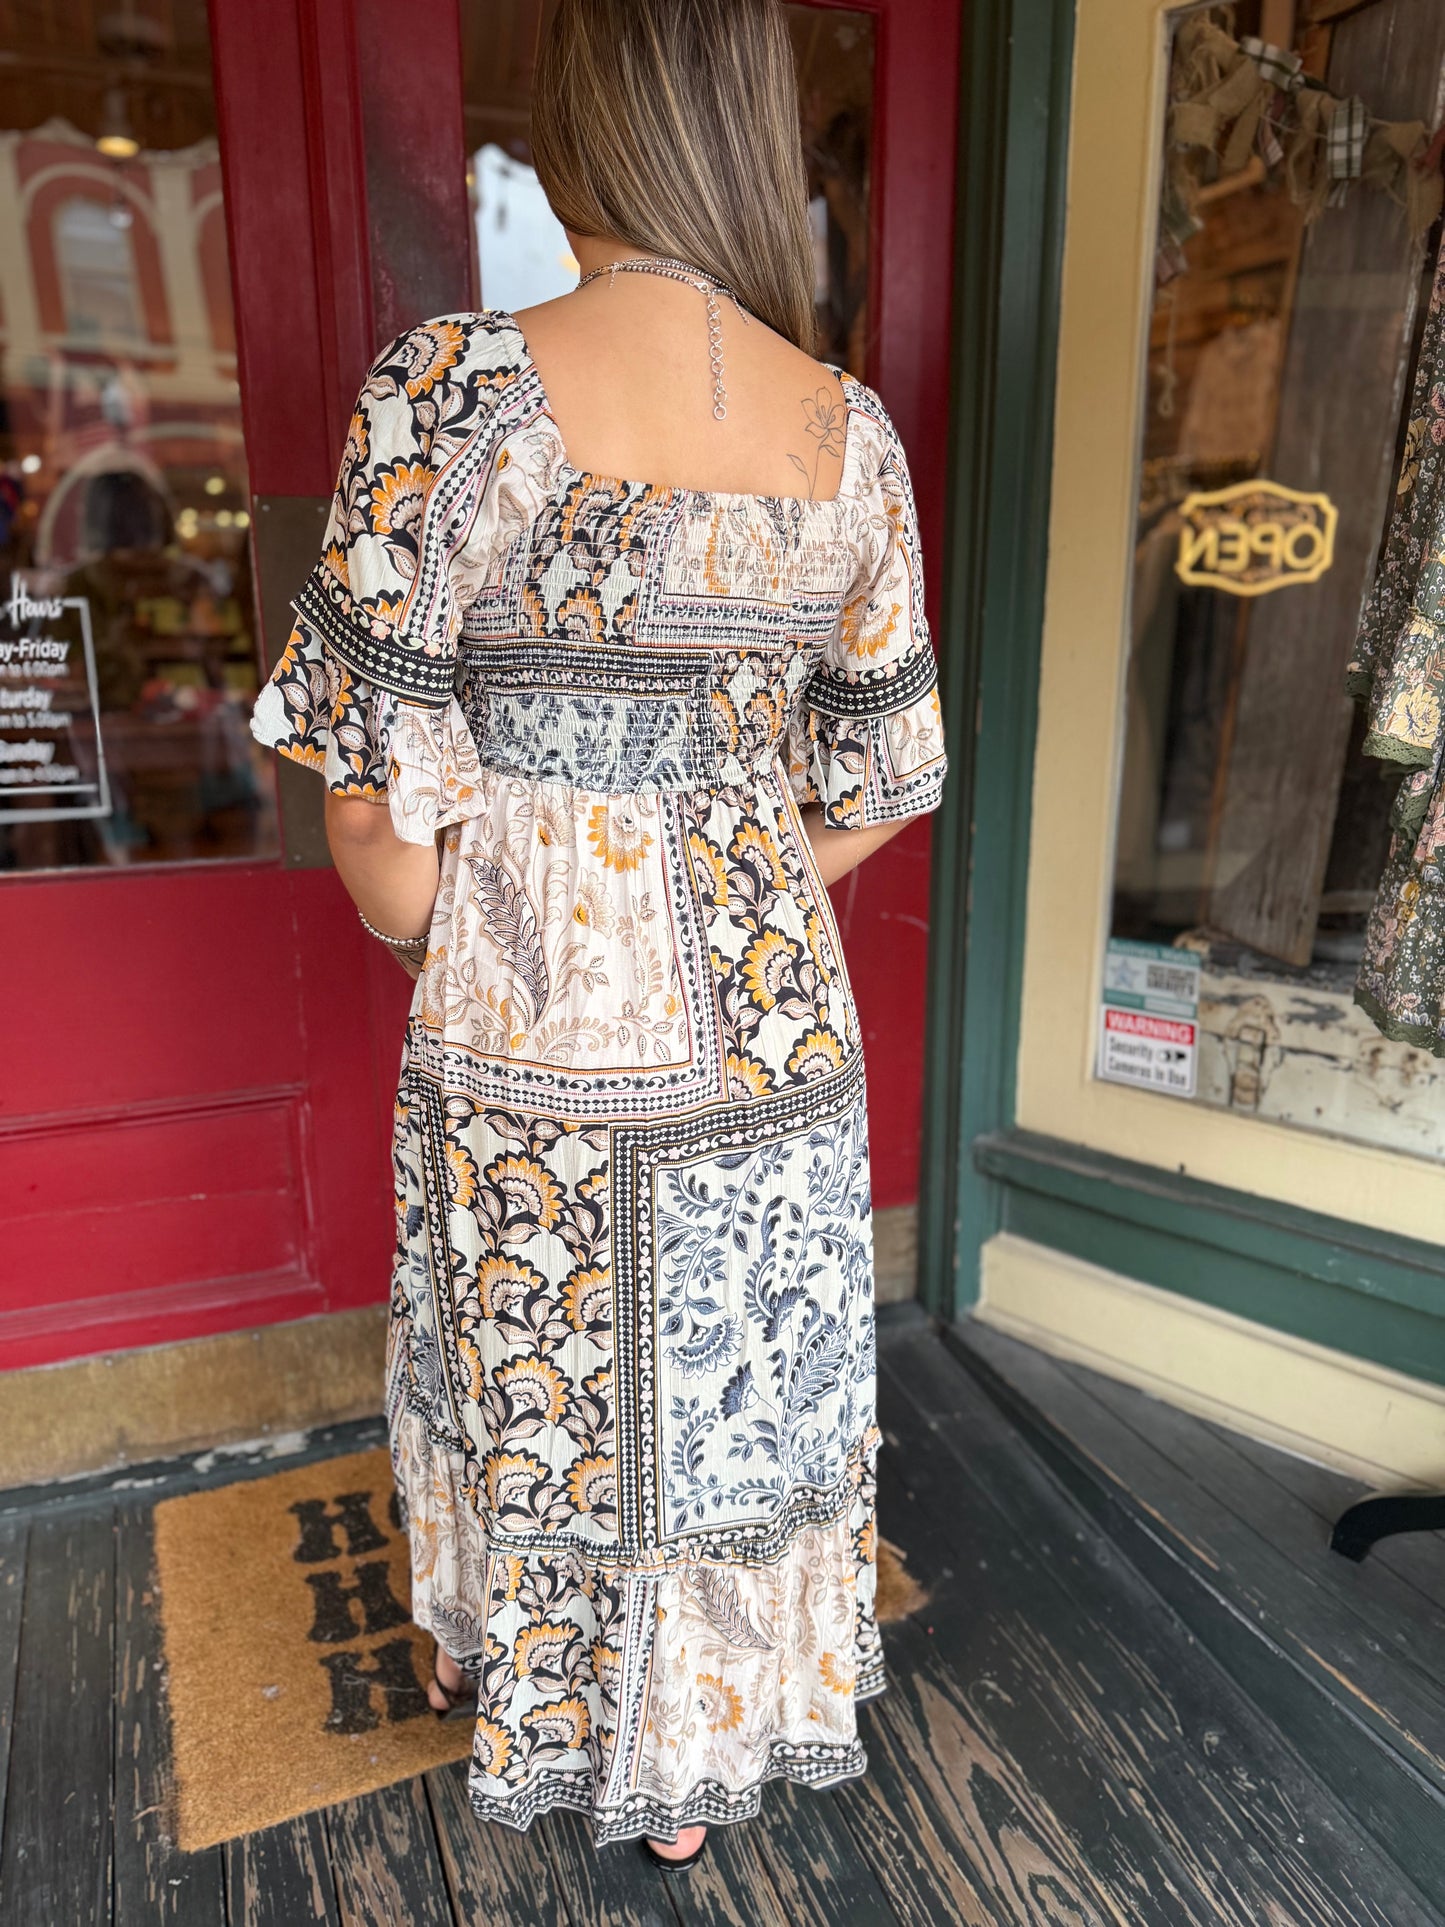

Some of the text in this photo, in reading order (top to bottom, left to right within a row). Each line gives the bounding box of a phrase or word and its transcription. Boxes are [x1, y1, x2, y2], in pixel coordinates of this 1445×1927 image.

[6, 571, 62, 628] Hours
[1108, 1010, 1191, 1044] WARNING
[1109, 1036, 1152, 1064] Security
[1108, 1056, 1151, 1079] Cameras
